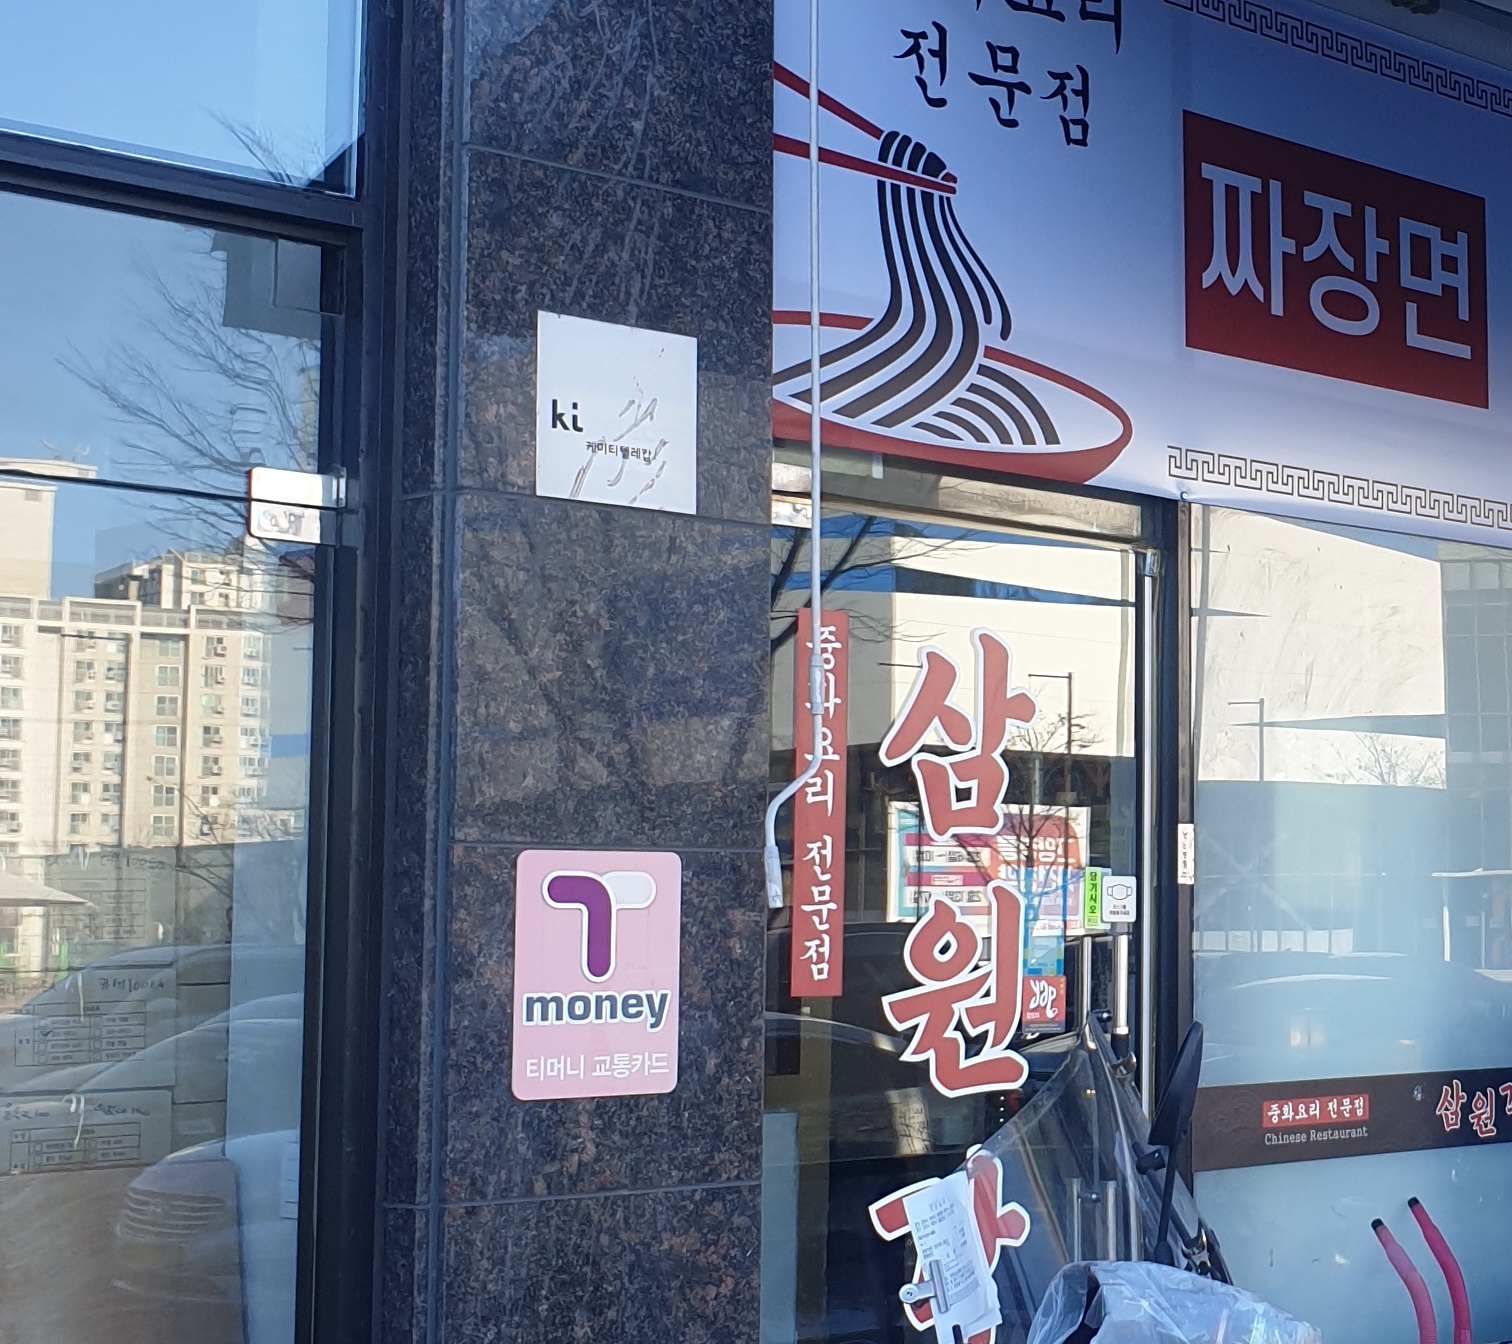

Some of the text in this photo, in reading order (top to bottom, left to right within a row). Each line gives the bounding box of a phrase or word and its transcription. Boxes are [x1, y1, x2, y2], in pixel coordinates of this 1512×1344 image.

[893, 21, 1089, 147] 전문점
[1201, 163, 1472, 361] 짜장면
[799, 834, 838, 981] 전문점
[524, 991, 671, 1032] money
[526, 1052, 670, 1081] 티머니 교통카드
[1267, 1097, 1364, 1124] 중화요리 전문점
[1265, 1125, 1368, 1146] Chinese Restaurant
